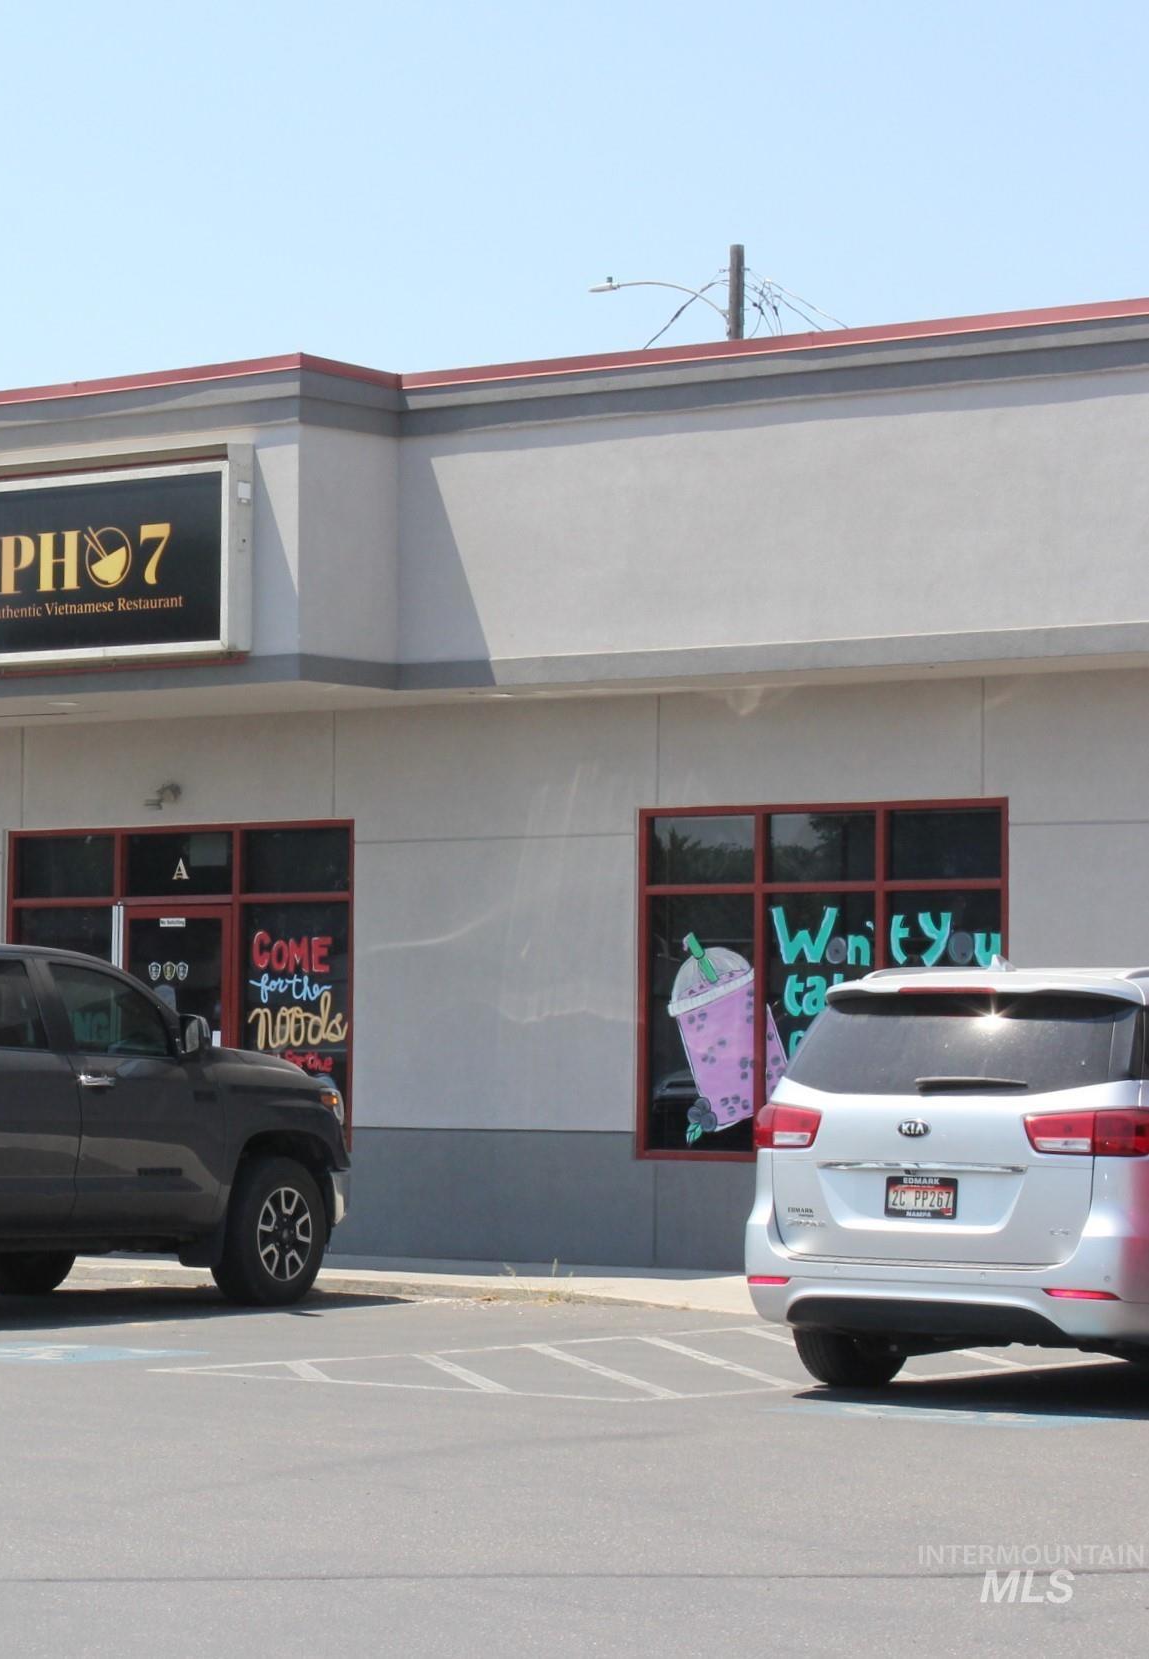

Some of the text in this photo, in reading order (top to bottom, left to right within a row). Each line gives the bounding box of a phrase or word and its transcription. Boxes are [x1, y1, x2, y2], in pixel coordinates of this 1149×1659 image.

[140, 523, 171, 584] 7
[44, 598, 114, 616] Vietnamese
[117, 595, 183, 612] Restaurant
[172, 857, 190, 880] A
[918, 911, 1001, 967] You
[253, 930, 332, 973] COME
[249, 973, 332, 1003] for the
[902, 1123, 925, 1134] KIA
[902, 1177, 940, 1185] EDMARK
[892, 1190, 952, 1208] 2C PP267
